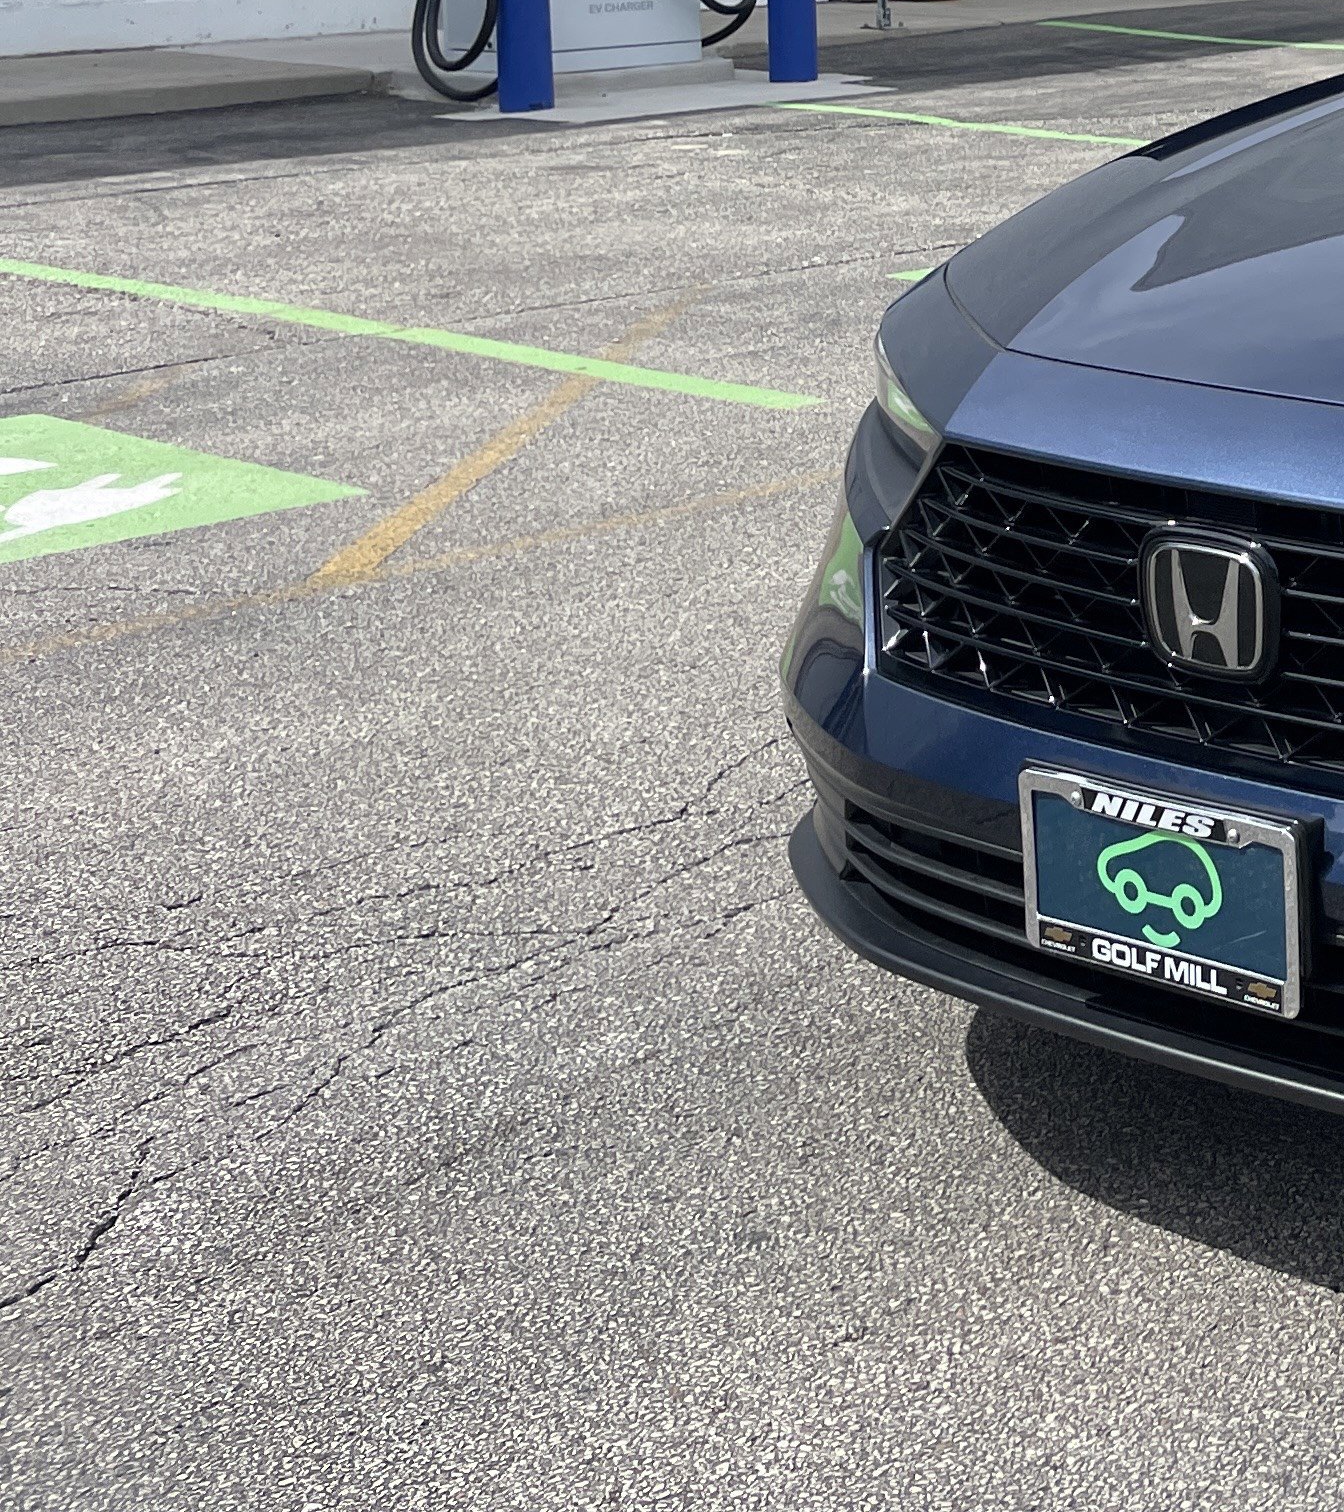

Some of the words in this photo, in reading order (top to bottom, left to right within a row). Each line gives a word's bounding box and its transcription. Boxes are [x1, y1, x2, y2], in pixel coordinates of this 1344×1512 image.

[589, 4, 602, 15] EV
[604, 0, 654, 13] CHARGER
[1091, 792, 1215, 838] NILES
[1091, 937, 1161, 974] GOLF
[1164, 956, 1228, 995] MILL
